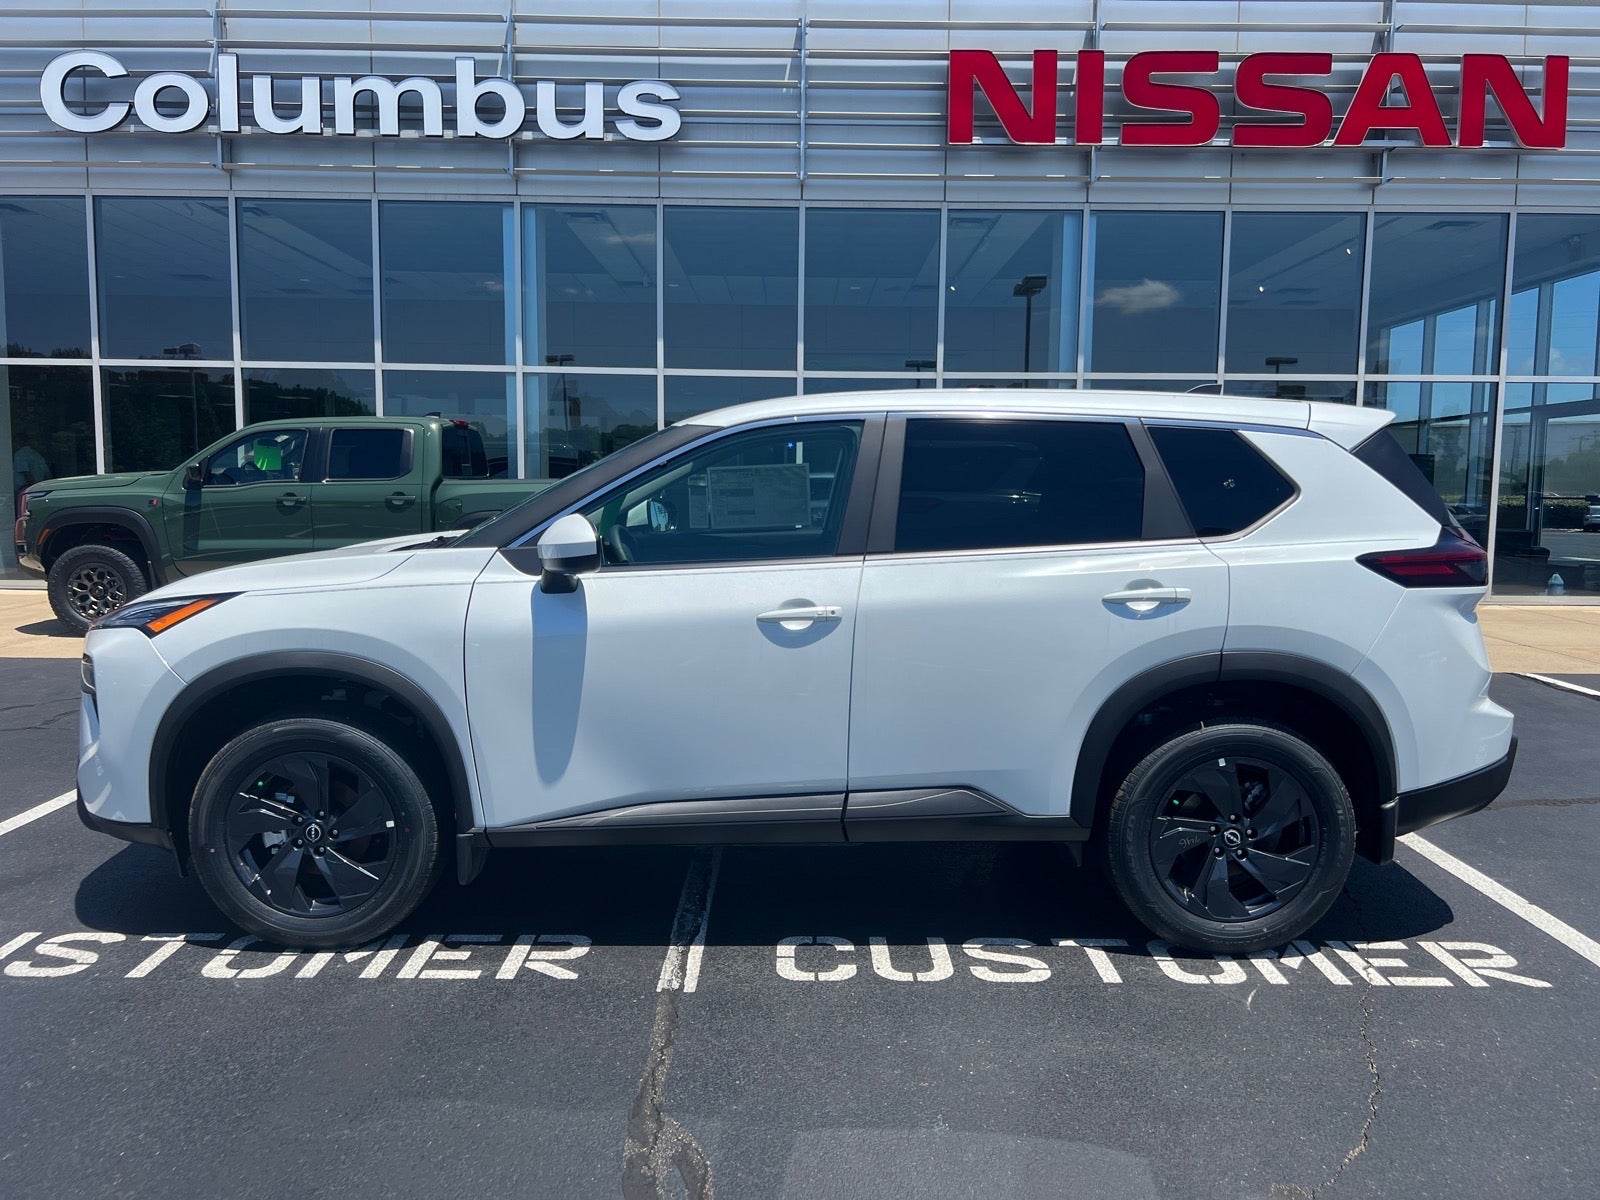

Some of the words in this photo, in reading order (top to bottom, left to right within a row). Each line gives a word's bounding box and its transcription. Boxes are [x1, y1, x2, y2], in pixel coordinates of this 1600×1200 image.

[40, 50, 682, 142] Columbus
[947, 49, 1570, 149] NISSAN
[775, 935, 1554, 988] CUSTOMER
